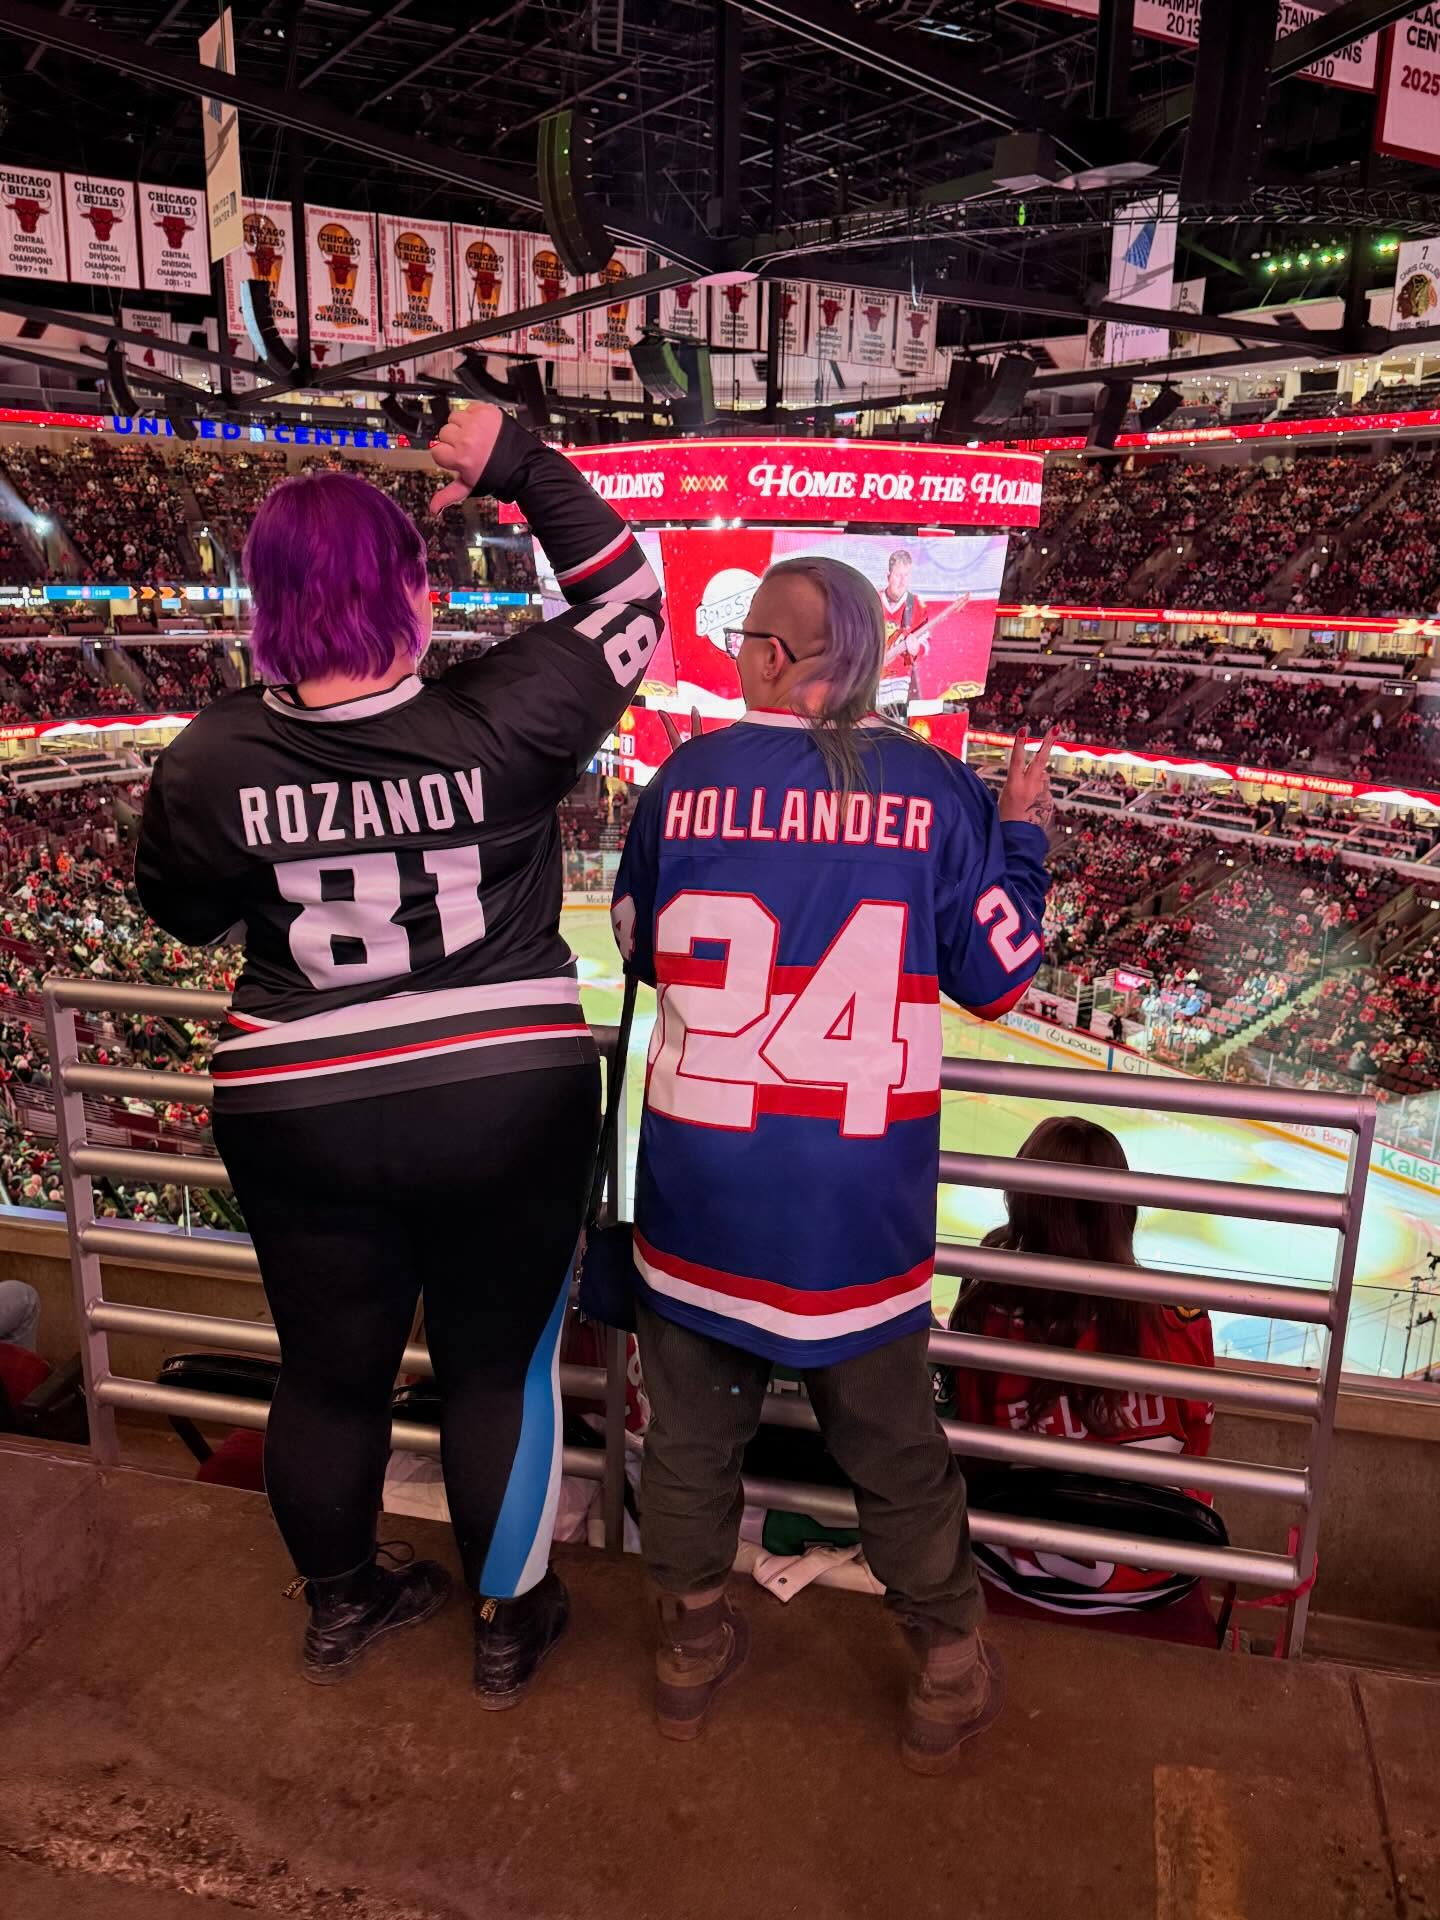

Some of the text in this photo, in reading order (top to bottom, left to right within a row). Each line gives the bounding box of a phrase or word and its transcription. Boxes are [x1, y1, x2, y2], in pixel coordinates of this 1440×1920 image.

[1166, 13, 1200, 38] 2013
[1407, 25, 1440, 54] CEN
[1401, 65, 1440, 96] 2025
[0, 172, 51, 188] CHICAGO
[8, 185, 45, 199] BULLS
[74, 181, 125, 197] CHICAGO
[83, 194, 119, 208] BULLS
[148, 191, 197, 206] CHICAGO
[156, 203, 191, 216] BULLS
[14, 234, 45, 245] CENTRAL
[320, 232, 361, 246] CHICAGO
[14, 244, 47, 255] DIVISION
[88, 242, 119, 252] CENTRAL
[327, 244, 356, 255] BULLS
[397, 241, 436, 256] CHICAGO
[1422, 245, 1429, 260] 7
[9, 254, 53, 265] CHAMPIONS
[89, 251, 120, 263] DIVISION
[161, 250, 190, 260] CENTRAL
[403, 252, 431, 264] BULLS
[84, 261, 126, 273] CHAMPIONS
[161, 259, 192, 269] DIVISION
[157, 268, 198, 279] CHAMPIONS
[1182, 287, 1189, 299] 3
[314, 313, 369, 326] CHAMPIONS
[392, 320, 443, 333] CHAMPIONS
[112, 414, 389, 449] UNIED CENTER
[748, 464, 856, 498] HOME
[860, 473, 915, 501] FOR
[919, 475, 967, 502] THE
[239, 767, 486, 847] ROZANOV
[664, 786, 934, 853] HOLLANDER
[273, 844, 486, 991] 81
[647, 888, 909, 1140] 24
